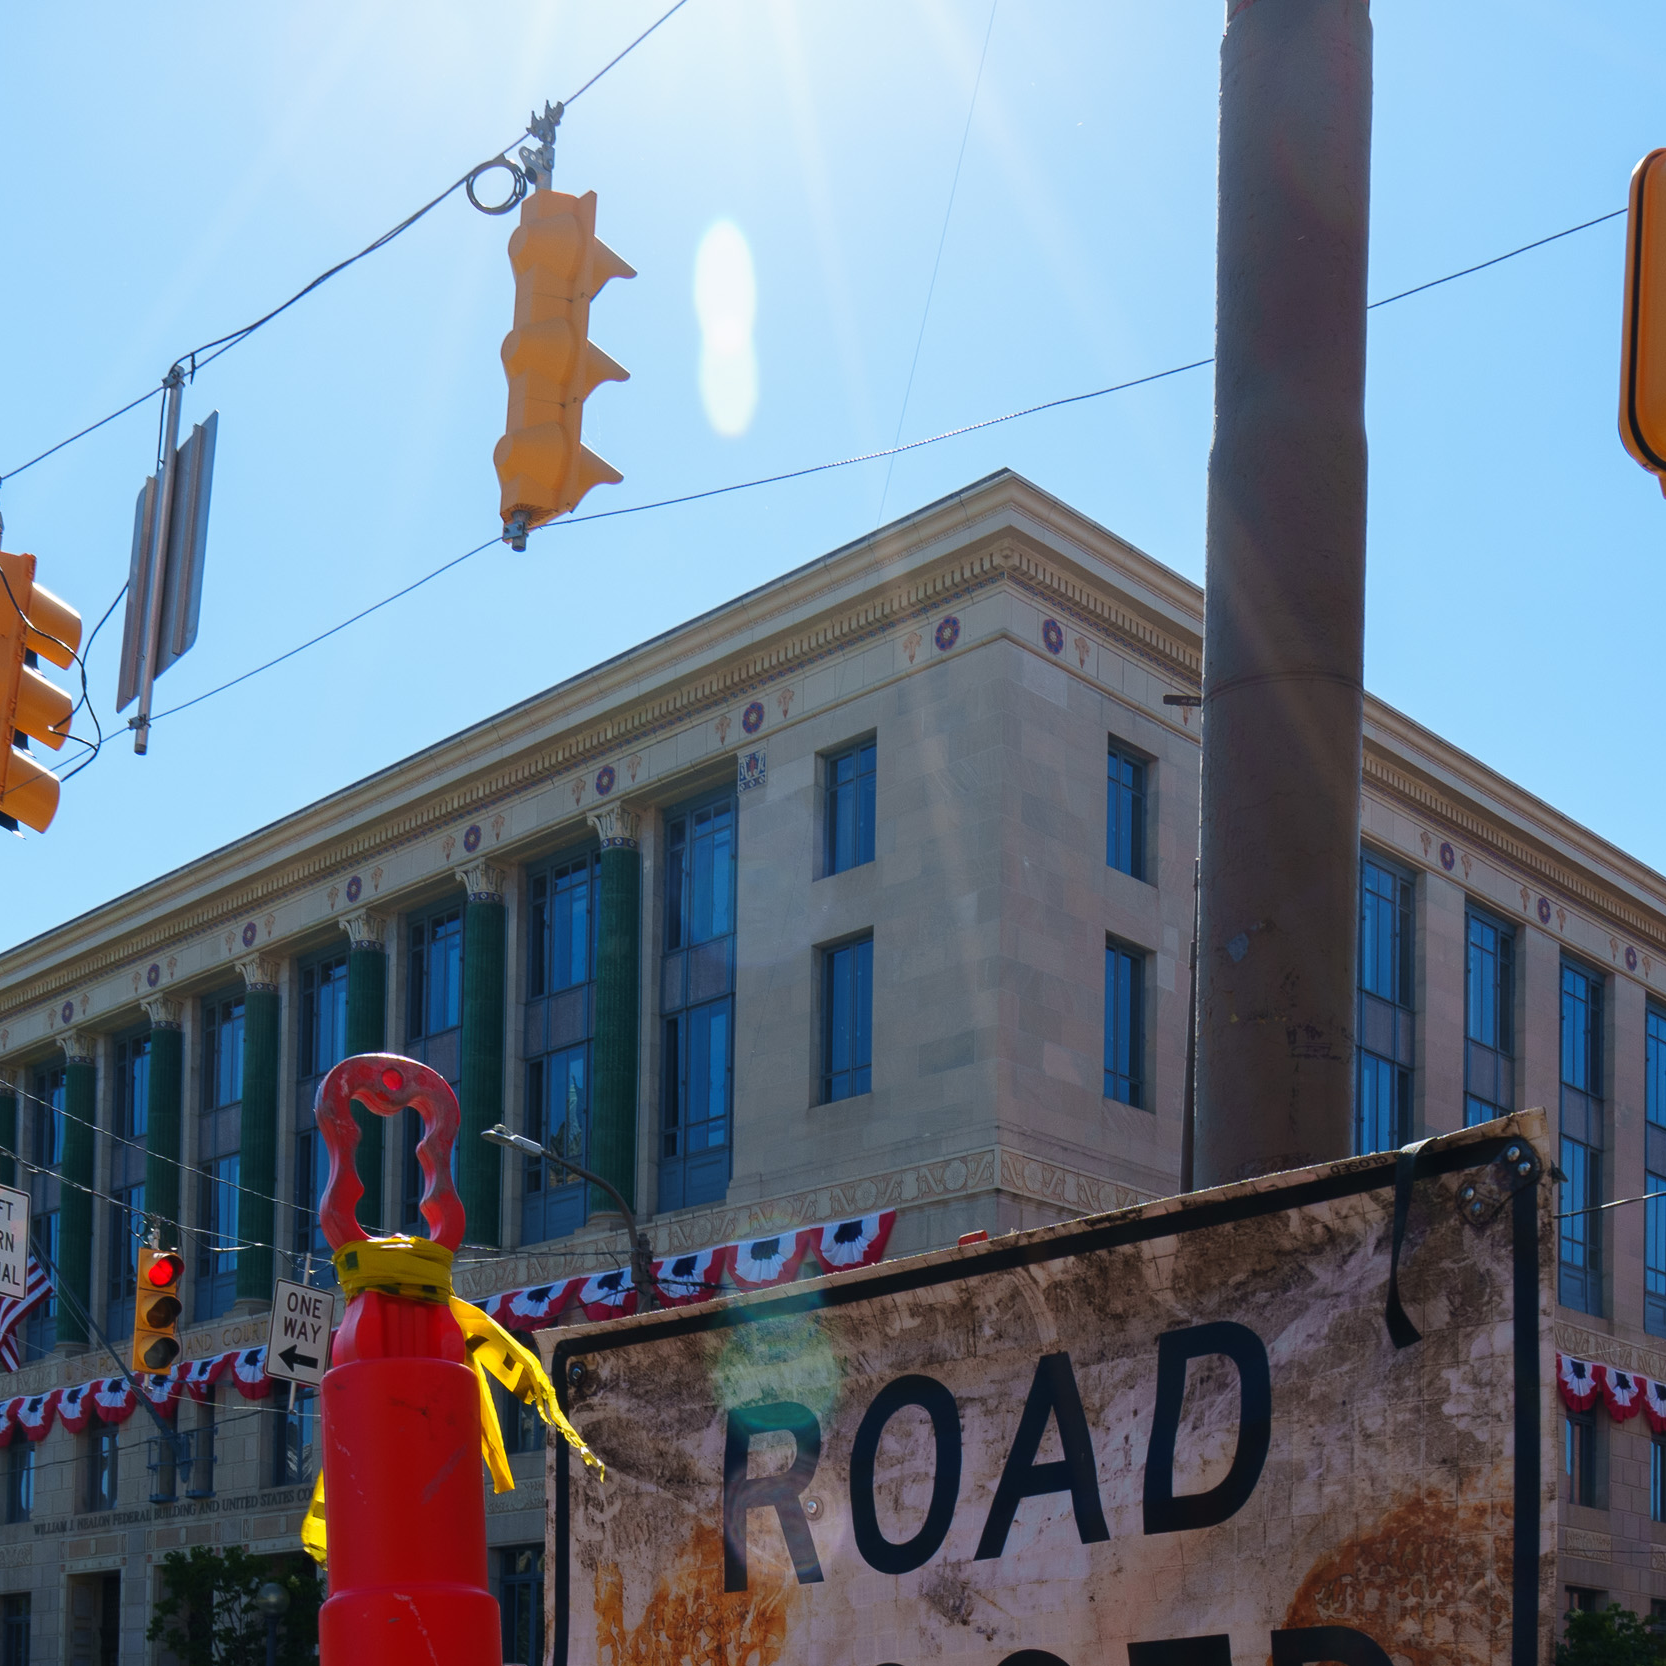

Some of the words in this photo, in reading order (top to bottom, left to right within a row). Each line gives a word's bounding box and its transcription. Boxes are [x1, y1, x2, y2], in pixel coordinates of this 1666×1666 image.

[286, 1291, 323, 1320] ONE
[185, 1333, 213, 1356] AND
[283, 1315, 322, 1345] WAY
[723, 1318, 1273, 1594] ROAD
[33, 1520, 68, 1535] WILLIAM
[77, 1516, 111, 1530] NEALON
[112, 1509, 152, 1526] FEDERAL
[154, 1502, 196, 1519] BUILDING
[198, 1501, 220, 1514] AND
[222, 1496, 258, 1511] UNITED
[260, 1490, 295, 1507] STATES
